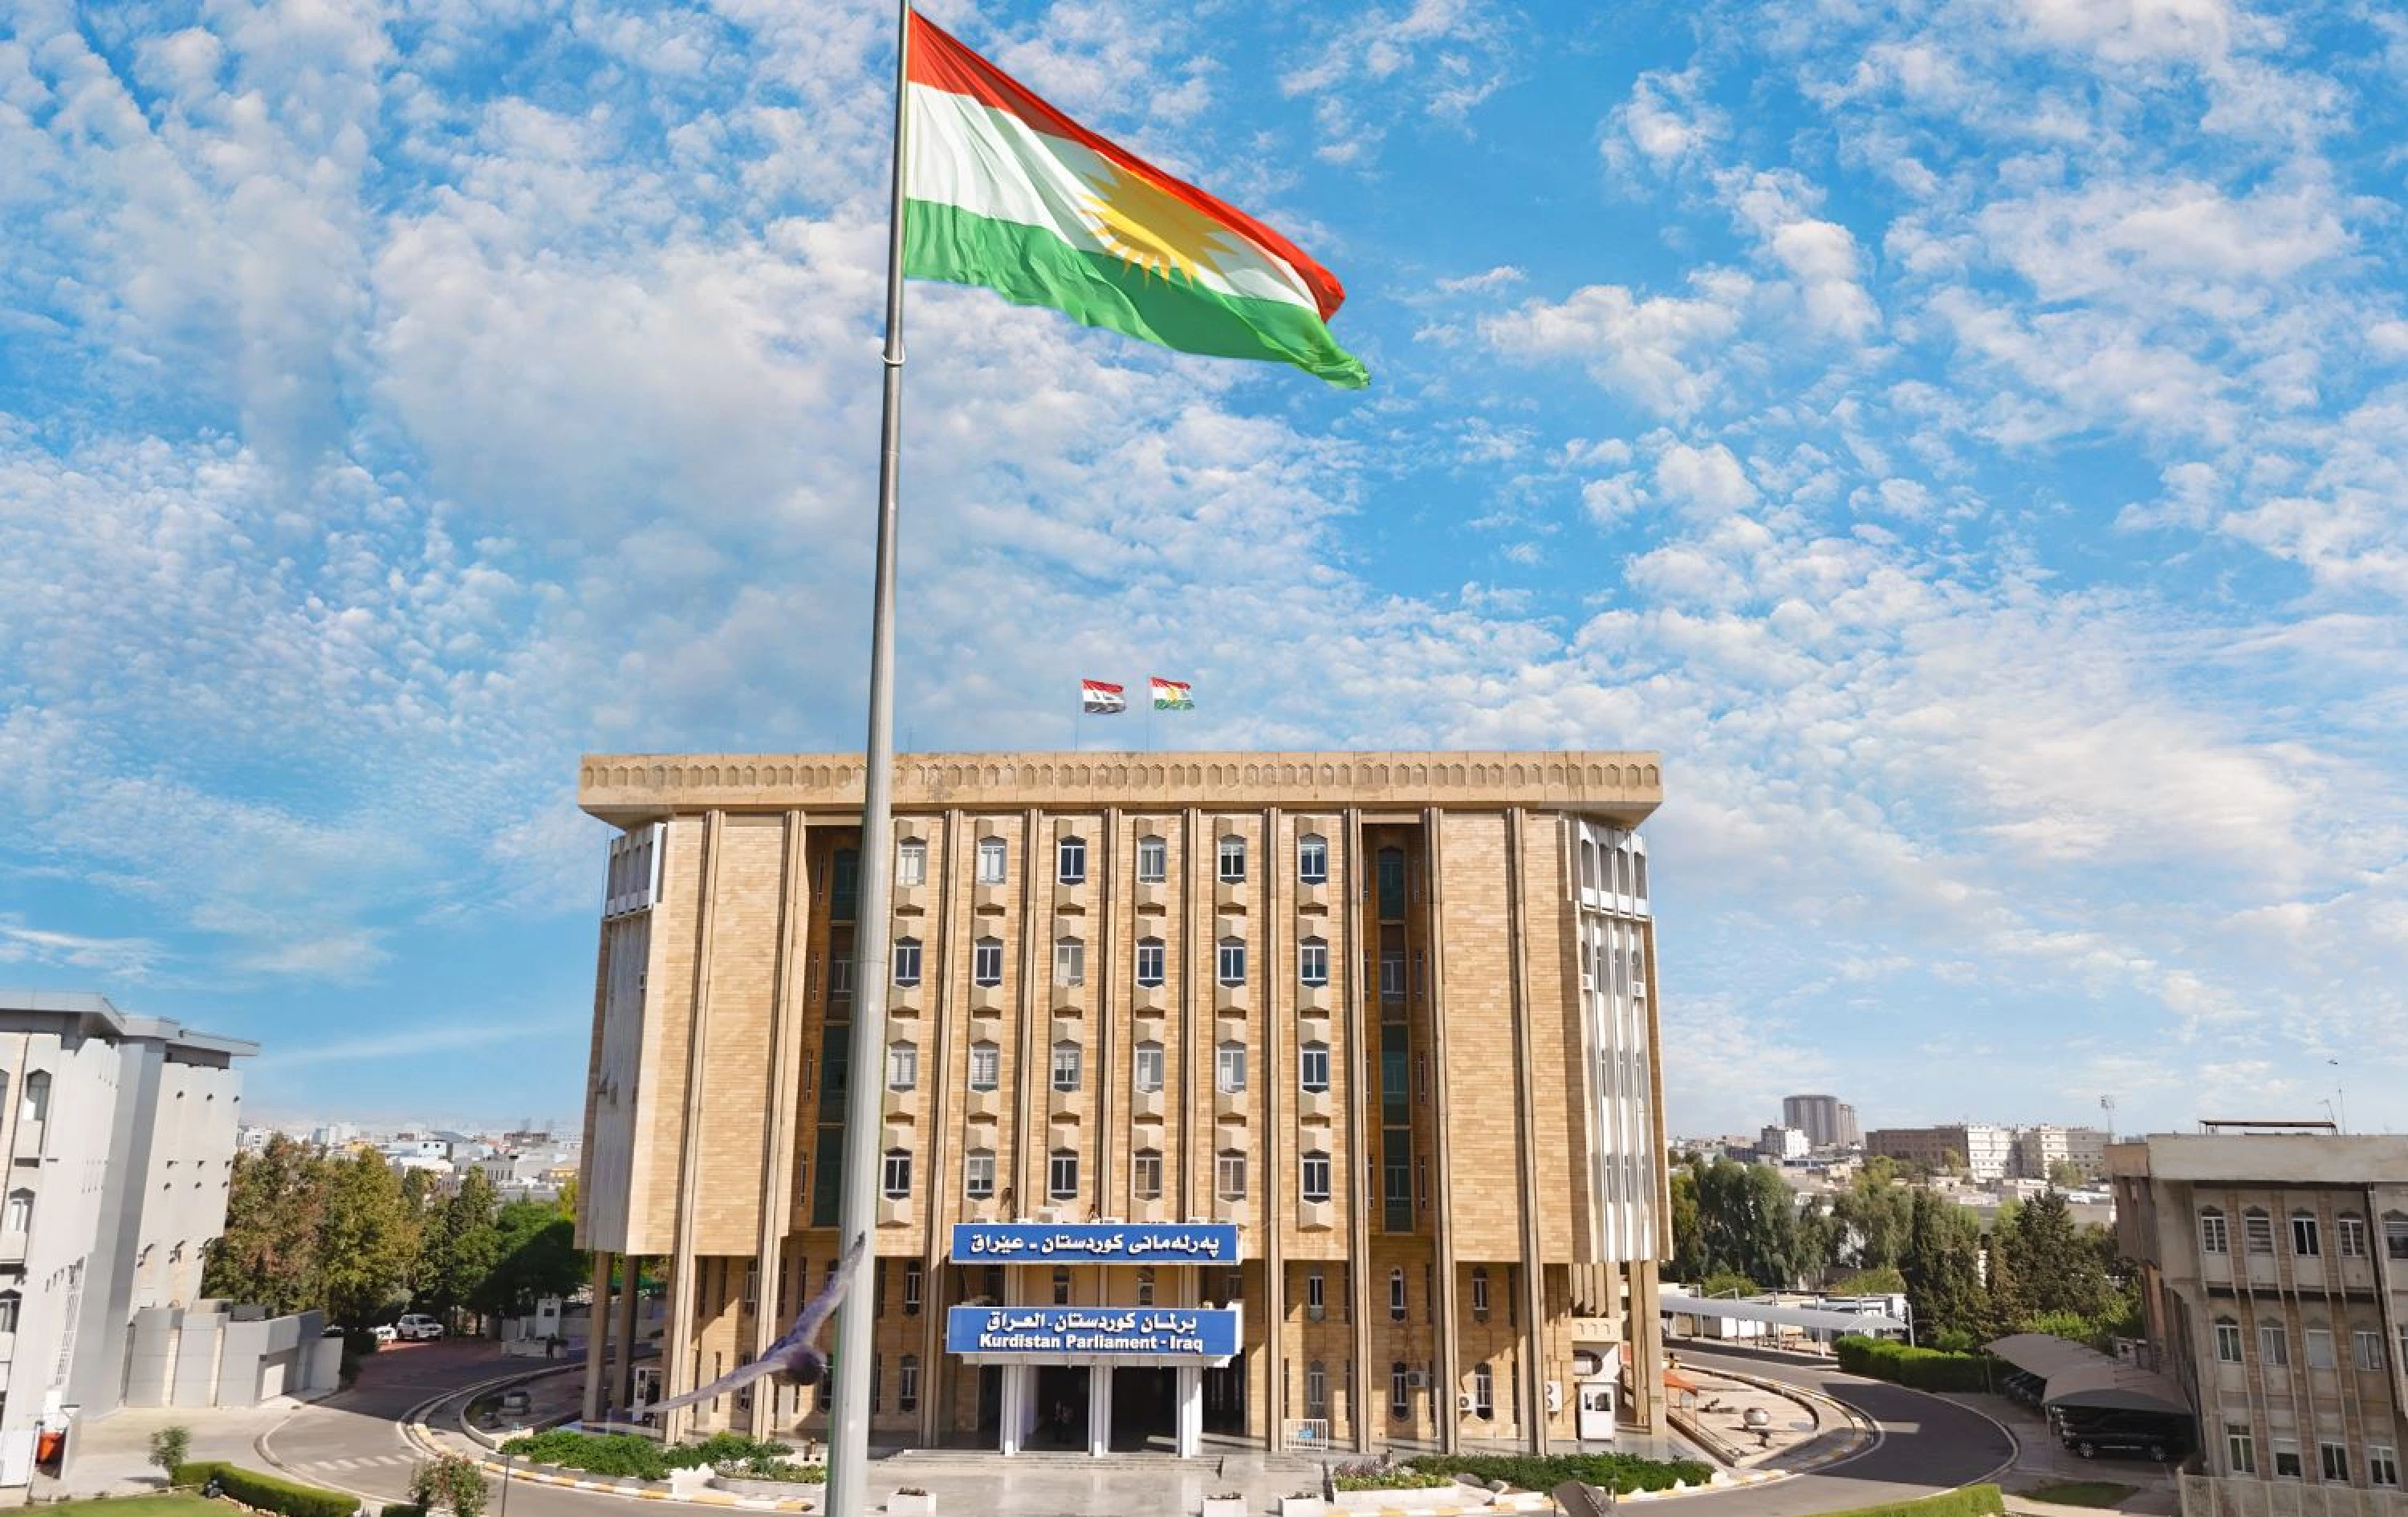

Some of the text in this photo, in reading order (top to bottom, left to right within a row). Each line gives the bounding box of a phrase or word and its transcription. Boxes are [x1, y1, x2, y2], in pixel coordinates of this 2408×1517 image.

[986, 1311, 1046, 1332] العراق
[979, 1333, 1060, 1348] Kurdistan
[1065, 1334, 1158, 1349] Parliament
[1169, 1335, 1203, 1352] Iraq
